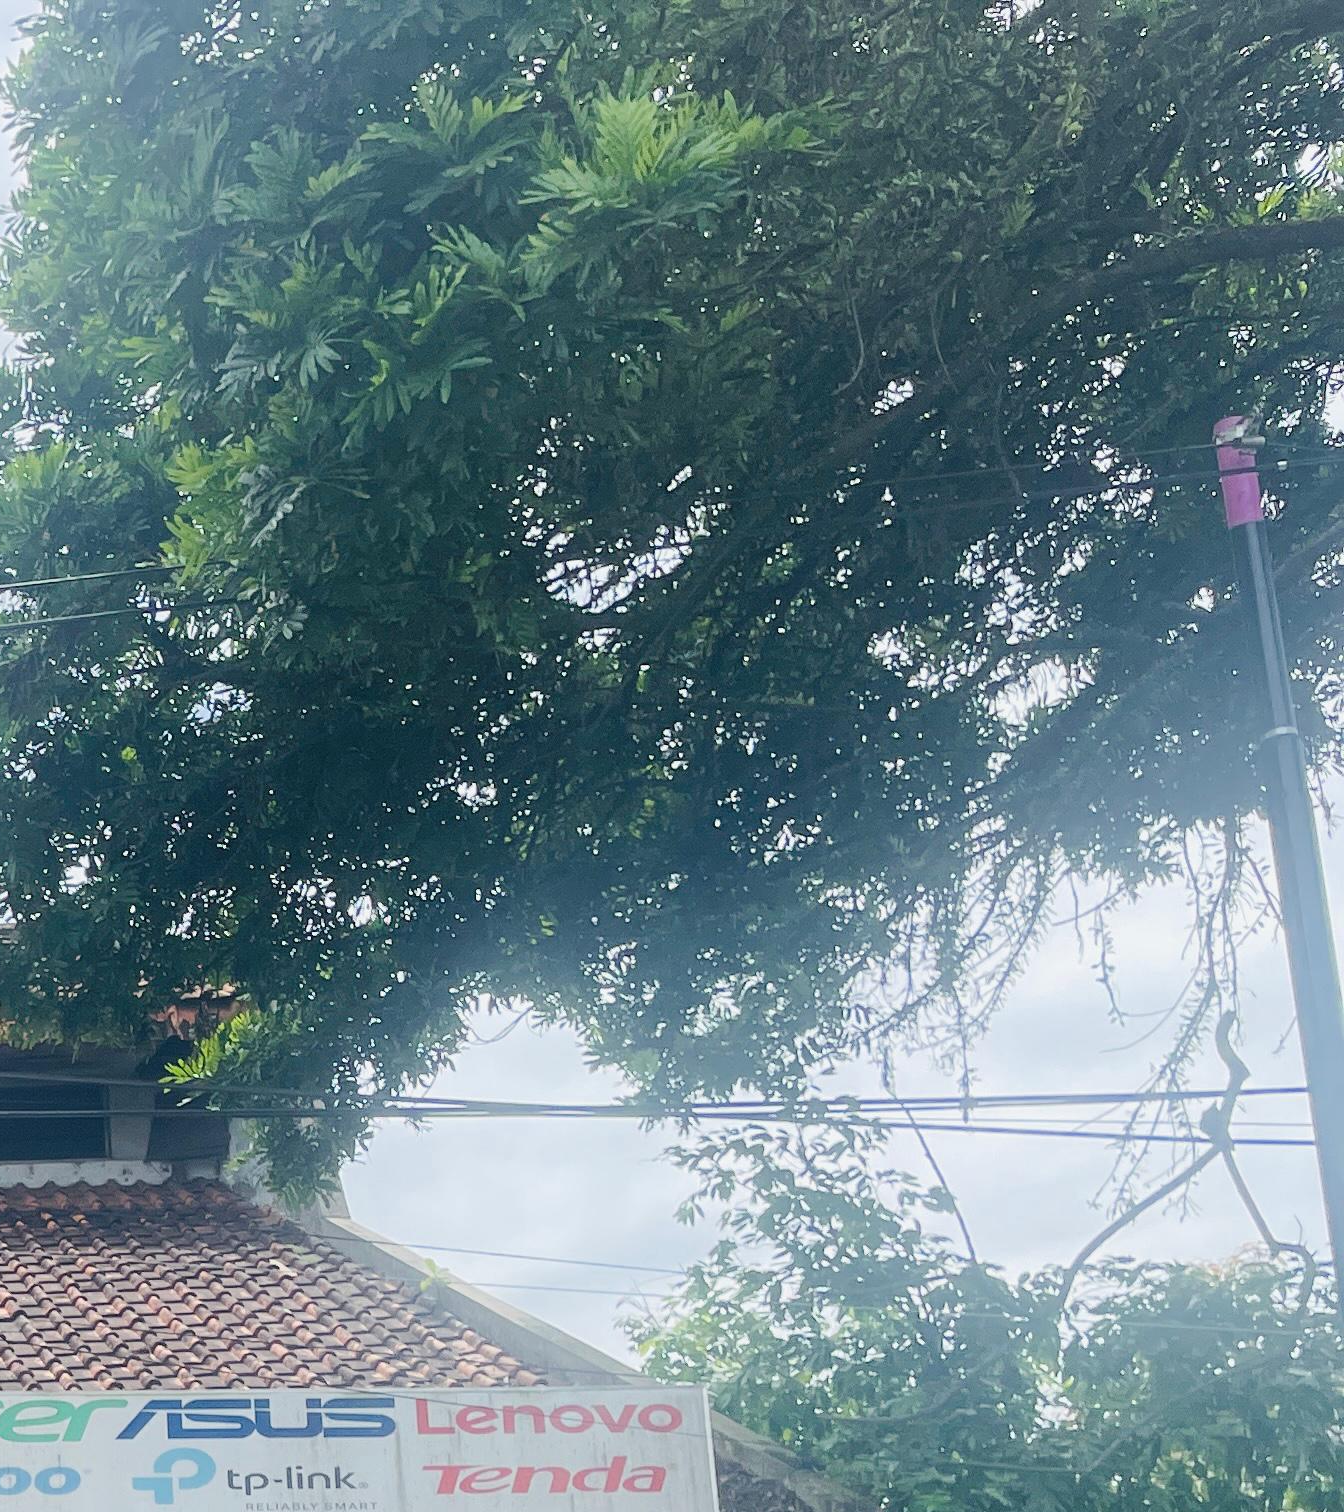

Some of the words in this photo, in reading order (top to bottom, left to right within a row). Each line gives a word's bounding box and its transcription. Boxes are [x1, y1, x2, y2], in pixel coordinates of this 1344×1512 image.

[116, 1399, 396, 1440] ASUS
[416, 1397, 682, 1435] Lenovo
[227, 1466, 357, 1495] tp-link
[424, 1456, 669, 1495] Tenda
[245, 1502, 318, 1511] RELIABLY
[324, 1502, 377, 1511] SMART
